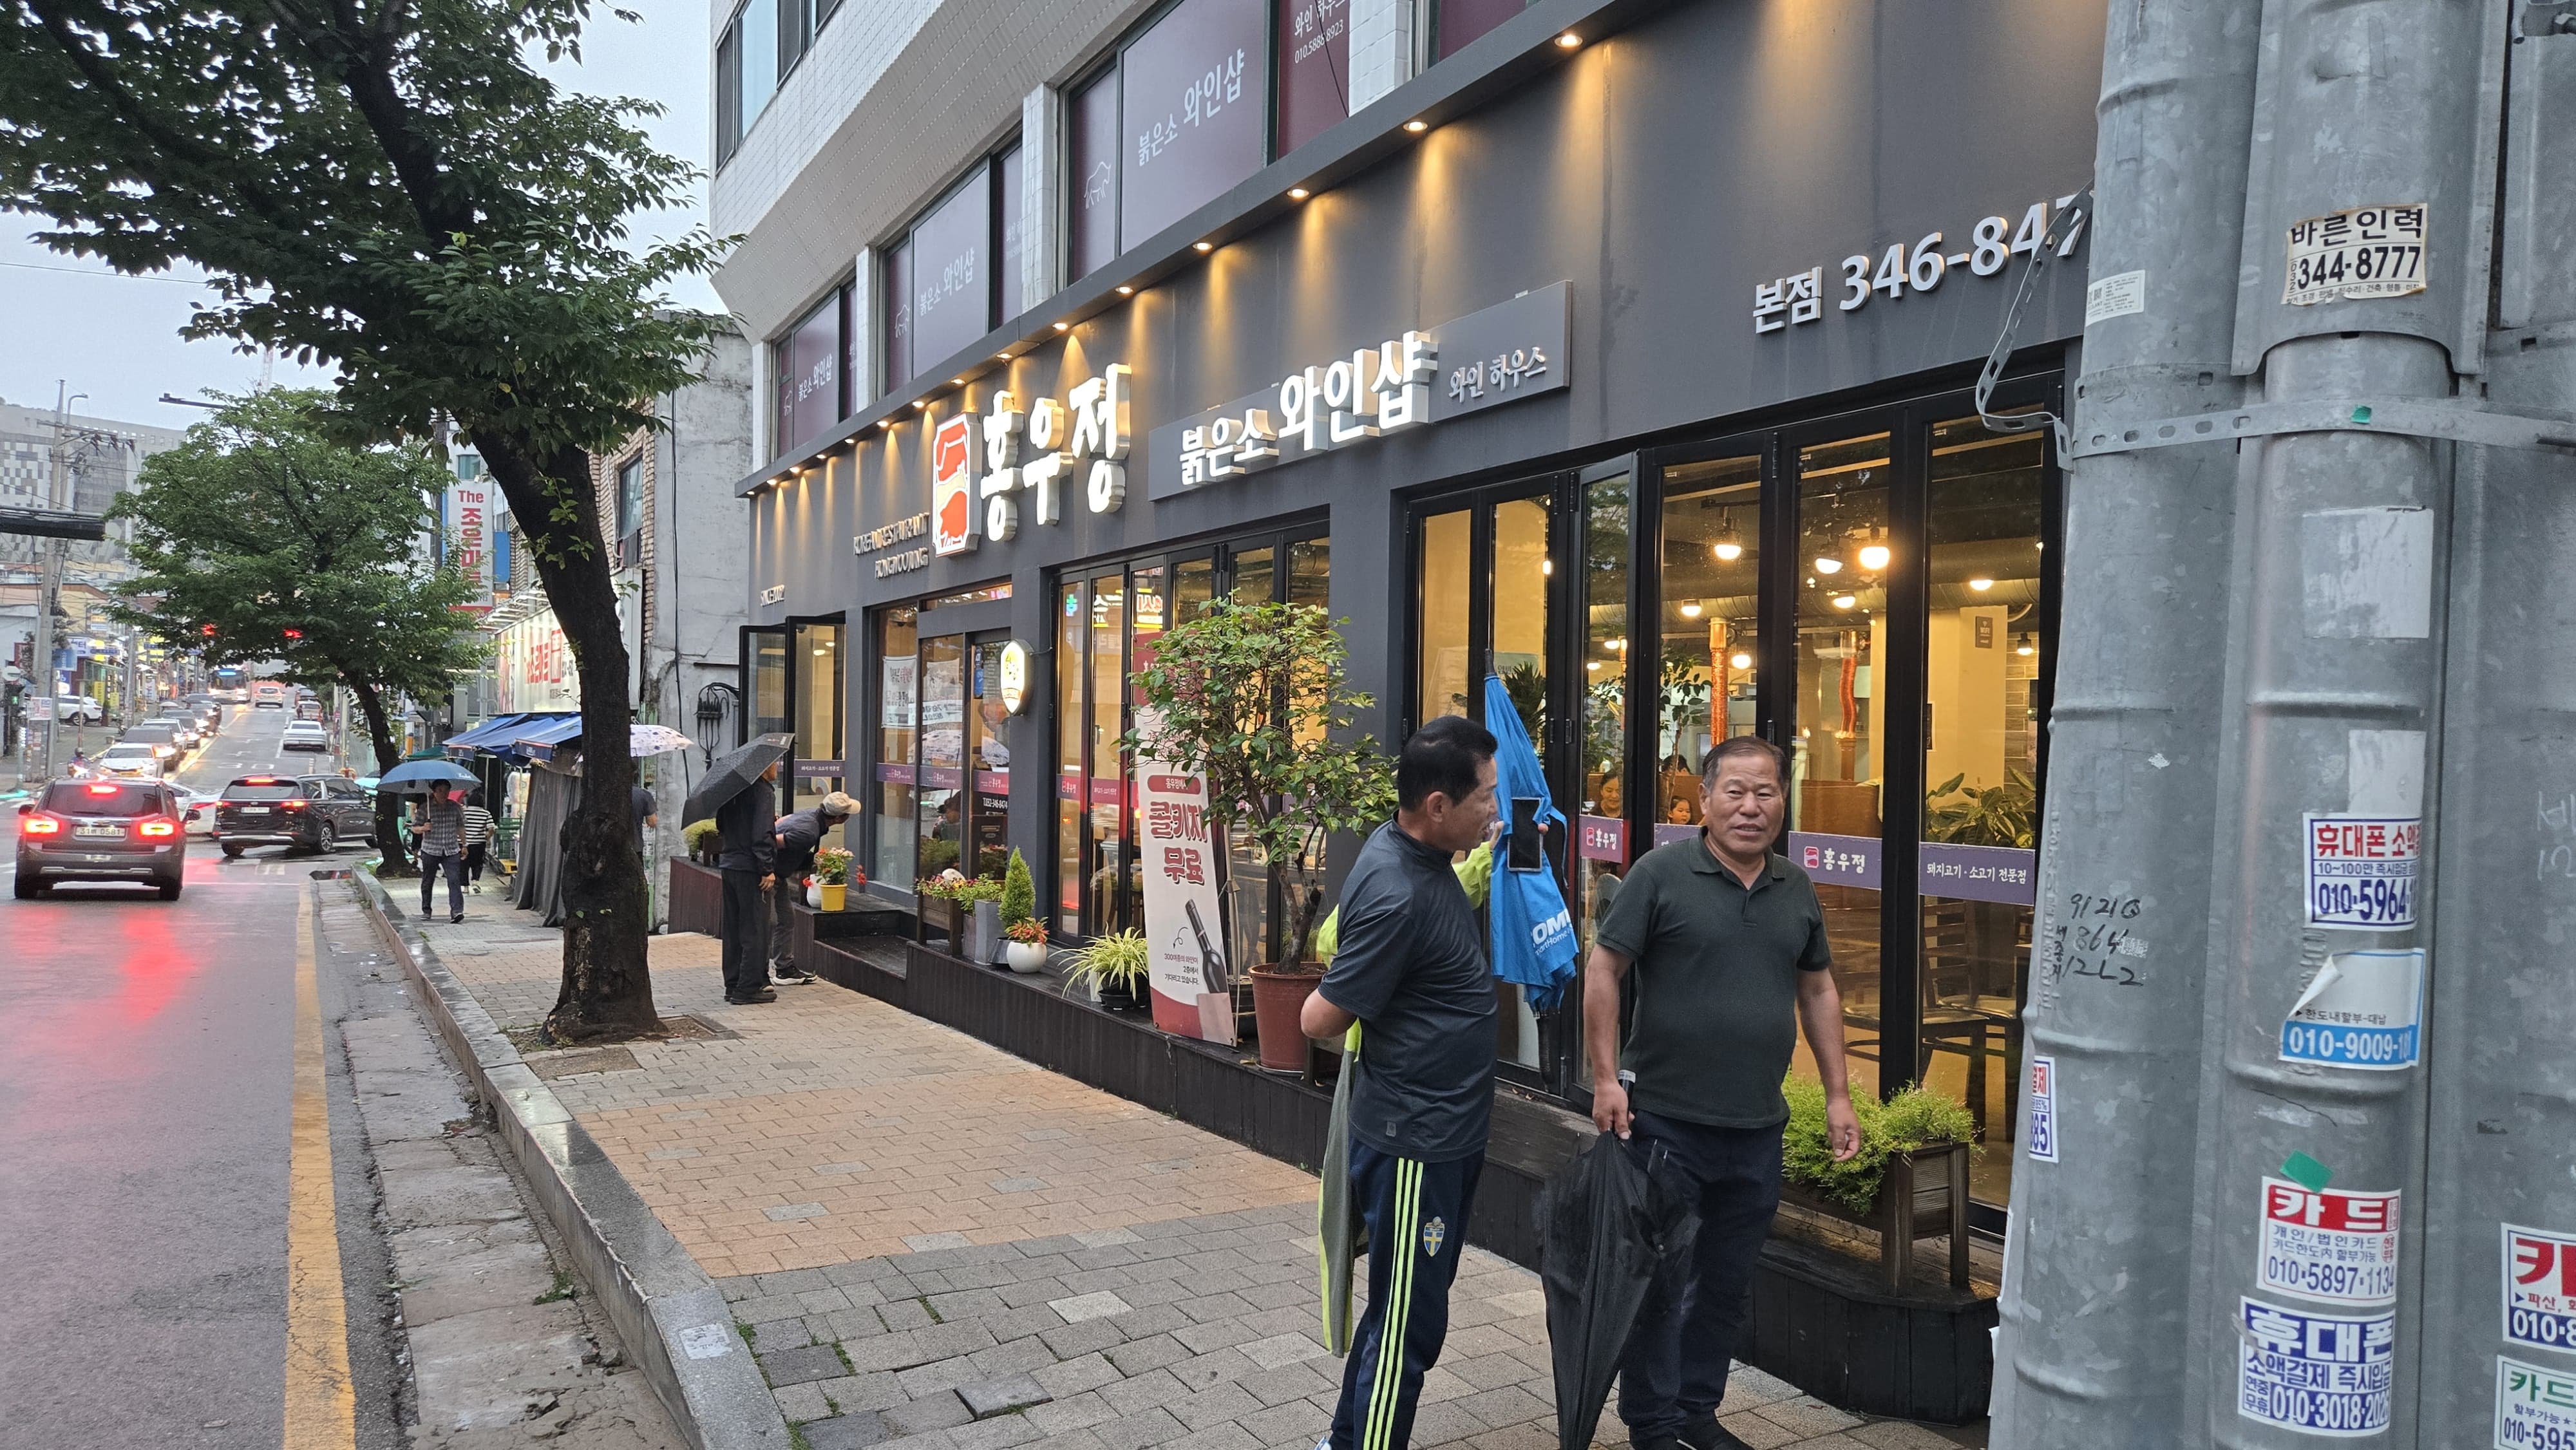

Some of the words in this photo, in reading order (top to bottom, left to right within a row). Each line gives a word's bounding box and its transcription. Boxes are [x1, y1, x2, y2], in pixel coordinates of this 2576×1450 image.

[1294, 5, 1313, 37] 와인
[1316, 0, 1345, 23] 하우
[1139, 113, 1178, 167] 붉은소
[1184, 48, 1245, 127] 와인샵
[2291, 208, 2423, 247] 바른인력
[920, 283, 941, 316] 붉은소
[943, 247, 974, 296] 와인샵
[2298, 246, 2421, 290] 344-8777
[1753, 267, 1823, 334] 본점
[813, 353, 832, 390] 와인샵
[1179, 409, 1279, 485] 붉은소
[1278, 330, 1439, 451] 와인샵
[1449, 362, 1484, 402] 와인
[1489, 346, 1547, 390] 하우스
[980, 363, 1132, 541] 홍우정
[458, 489, 484, 504] The
[1149, 801, 1208, 842] 콜키지
[1596, 827, 1617, 851] 홍우정
[2317, 824, 2385, 857] 휴대폰
[1164, 846, 1204, 885] 무료
[1823, 848, 1866, 874] 홍우정
[1927, 862, 1961, 879] 돼지고기
[1969, 866, 1995, 882] 소고기
[1998, 869, 2027, 885] 전문점
[2273, 1189, 2383, 1229] 카드
[2337, 1248, 2376, 1263] 할부가능
[2249, 1309, 2393, 1363] 휴대폰
[2247, 1350, 2330, 1389] 소액결제
[2509, 1370, 2576, 1409] 카드
